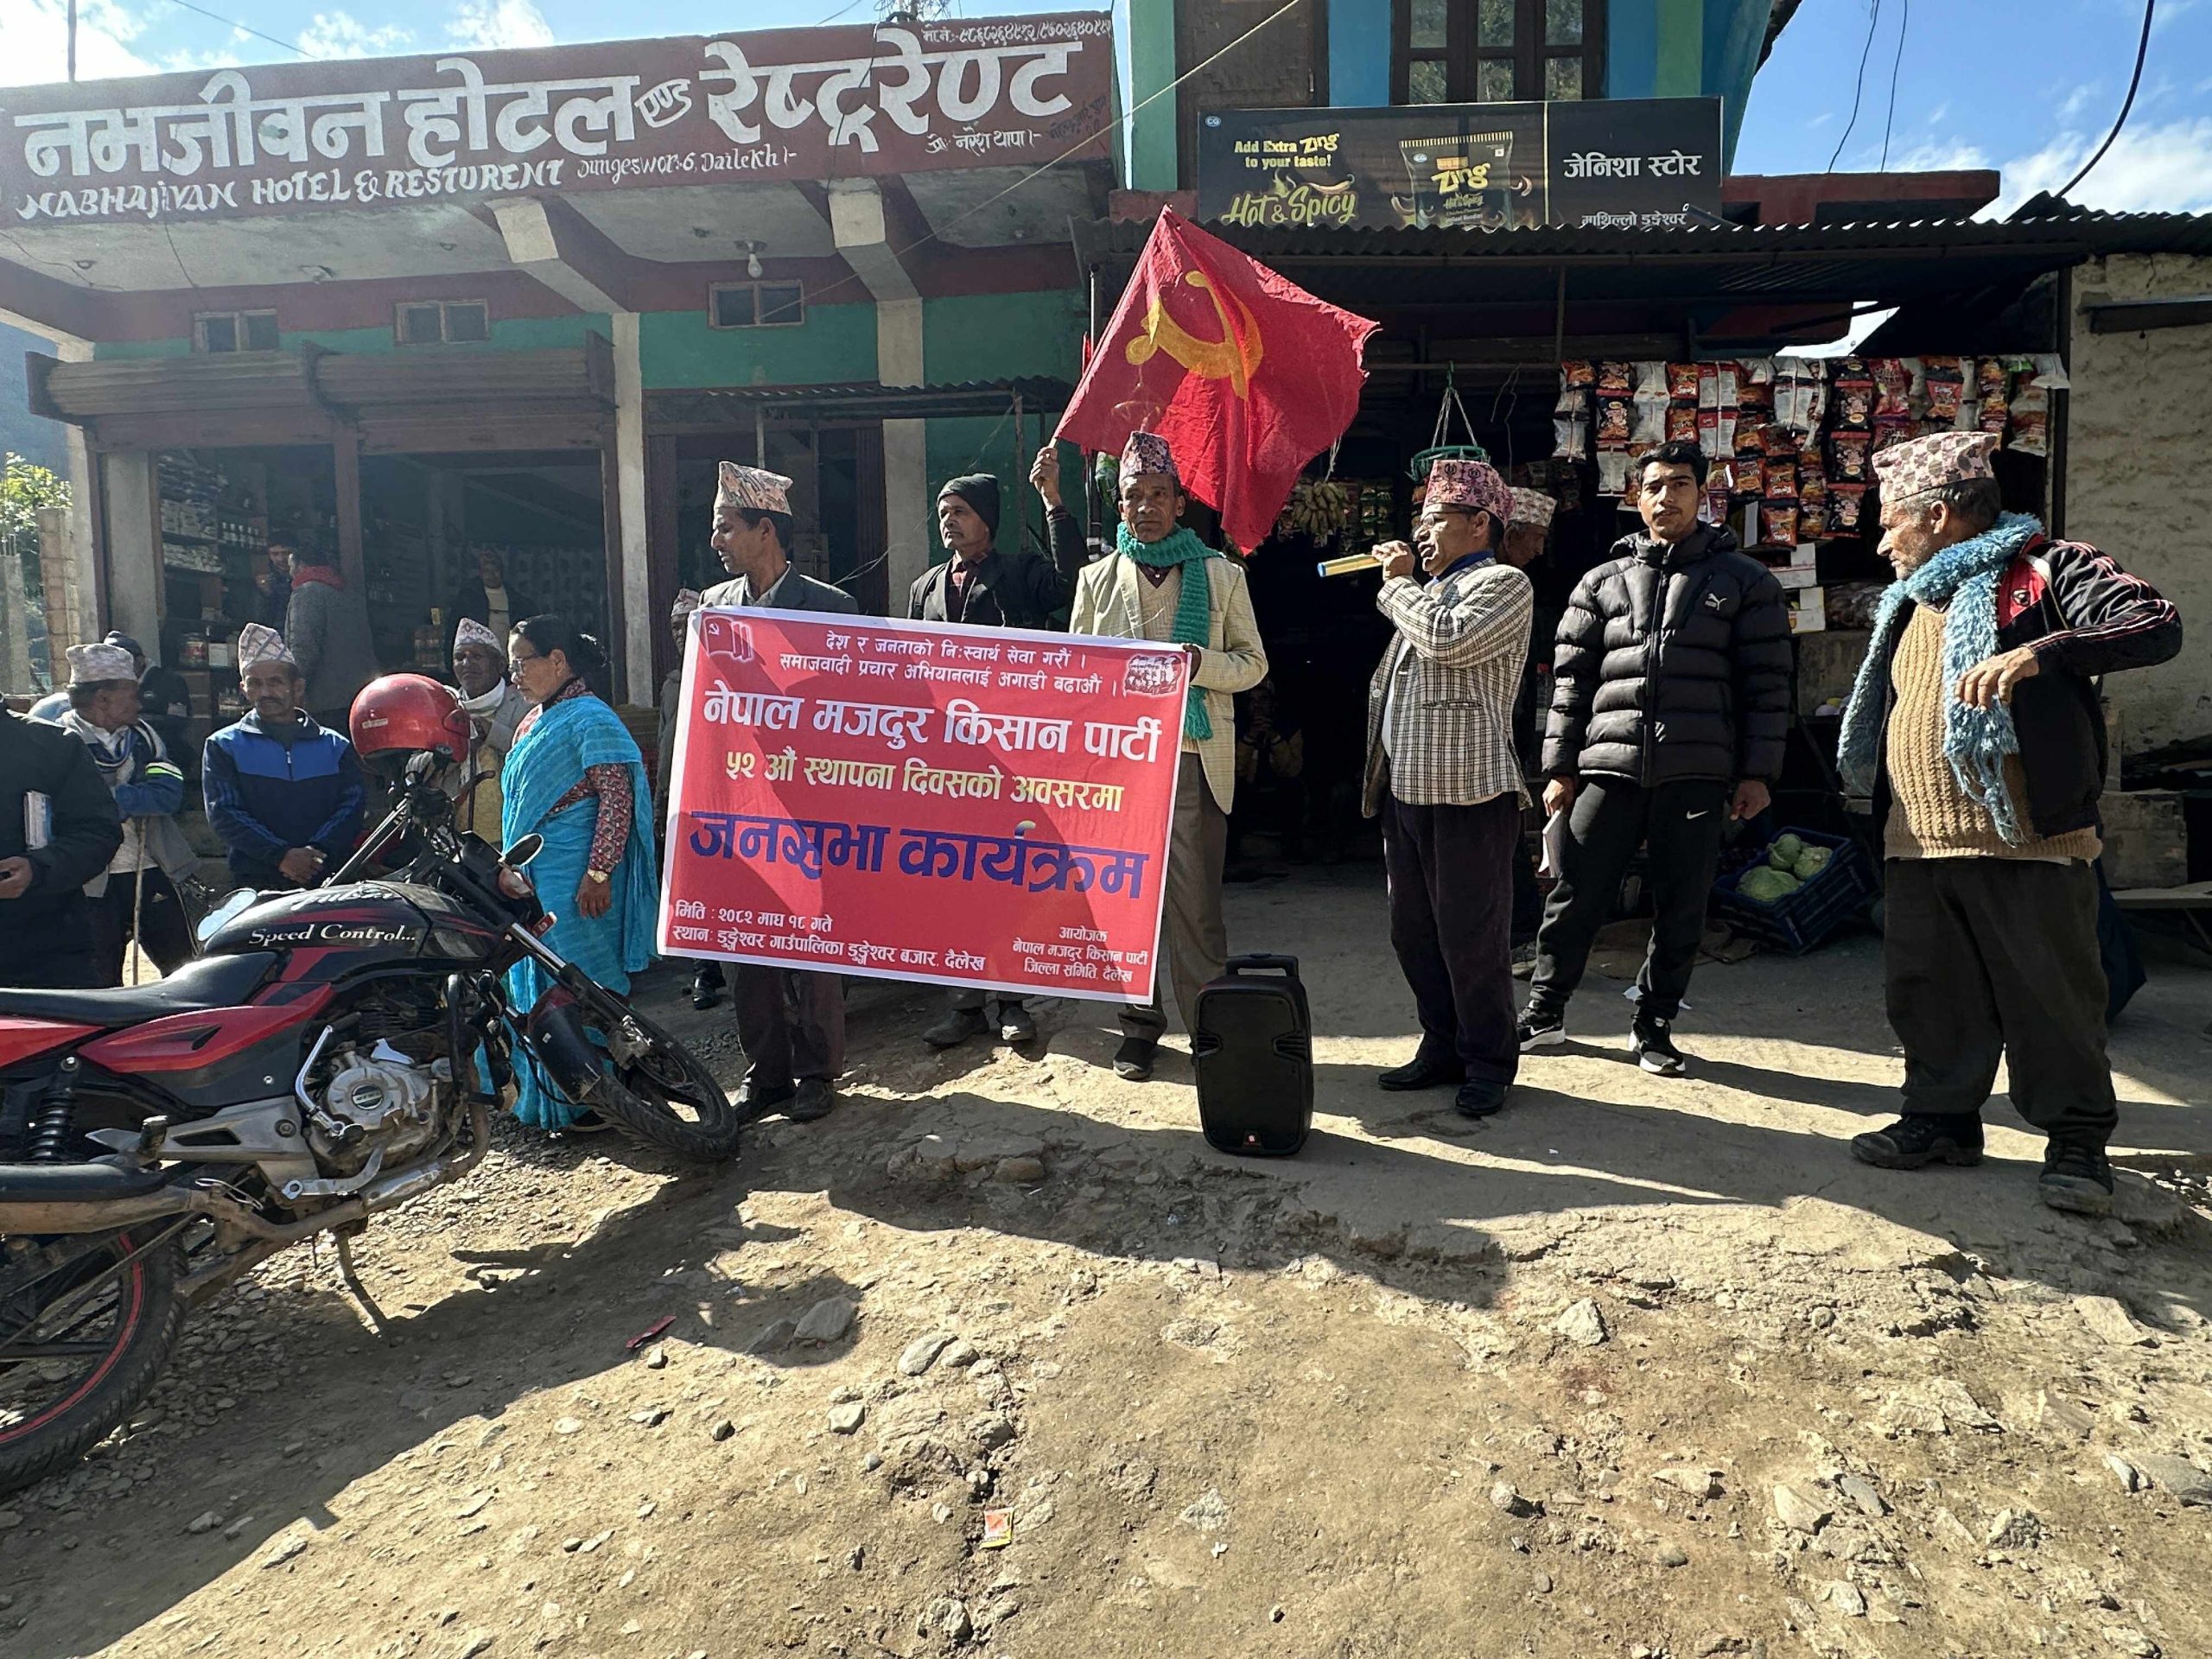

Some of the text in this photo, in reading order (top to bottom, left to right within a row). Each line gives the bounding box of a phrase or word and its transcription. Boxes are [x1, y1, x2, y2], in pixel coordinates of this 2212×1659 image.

[397, 57, 640, 168] होटल
[952, 126, 992, 156] नरेश
[1234, 133, 1339, 154] Add Extra Zing
[1245, 154, 1332, 170] to your taste!
[1431, 162, 1491, 195] Zing
[1563, 150, 1702, 177] जेनिशा स्टोर
[251, 168, 351, 205] HOTEL
[353, 169, 382, 202] &
[385, 159, 564, 199] RESTURENT
[1221, 186, 1357, 227] Hot & Spicy
[827, 631, 851, 650] देश
[857, 637, 868, 653] र
[875, 639, 934, 657] जनताको
[1007, 645, 1036, 664] सेवा
[1043, 647, 1072, 669] गरौं
[780, 653, 852, 676] समाजवादी
[859, 660, 898, 681] प्रचार
[905, 660, 993, 688] अभियानलाई
[998, 670, 1047, 690] अगाडी
[703, 680, 1162, 763] नेपाल मजदुर किसान पार्टी
[726, 751, 755, 780] ५२
[804, 757, 896, 791] स्थापना
[902, 757, 1004, 800] दिवसको
[1010, 775, 1124, 812] अवसरमा
[690, 811, 1150, 899] जनसभा कार्यक्रम
[676, 899, 706, 920] मिति
[718, 908, 753, 925] २०८२
[758, 912, 785, 927] माघ
[788, 915, 806, 930] १८
[810, 914, 833, 932] गते
[249, 923, 416, 948] Speed Control...
[1059, 925, 1108, 943] आयोजक
[945, 949, 986, 971] दैलेख
[1013, 938, 1148, 965] नेपाल मजदुर किसान पार्टी
[1024, 957, 1060, 975] जिल्ला
[1103, 964, 1133, 982] दैलेख
